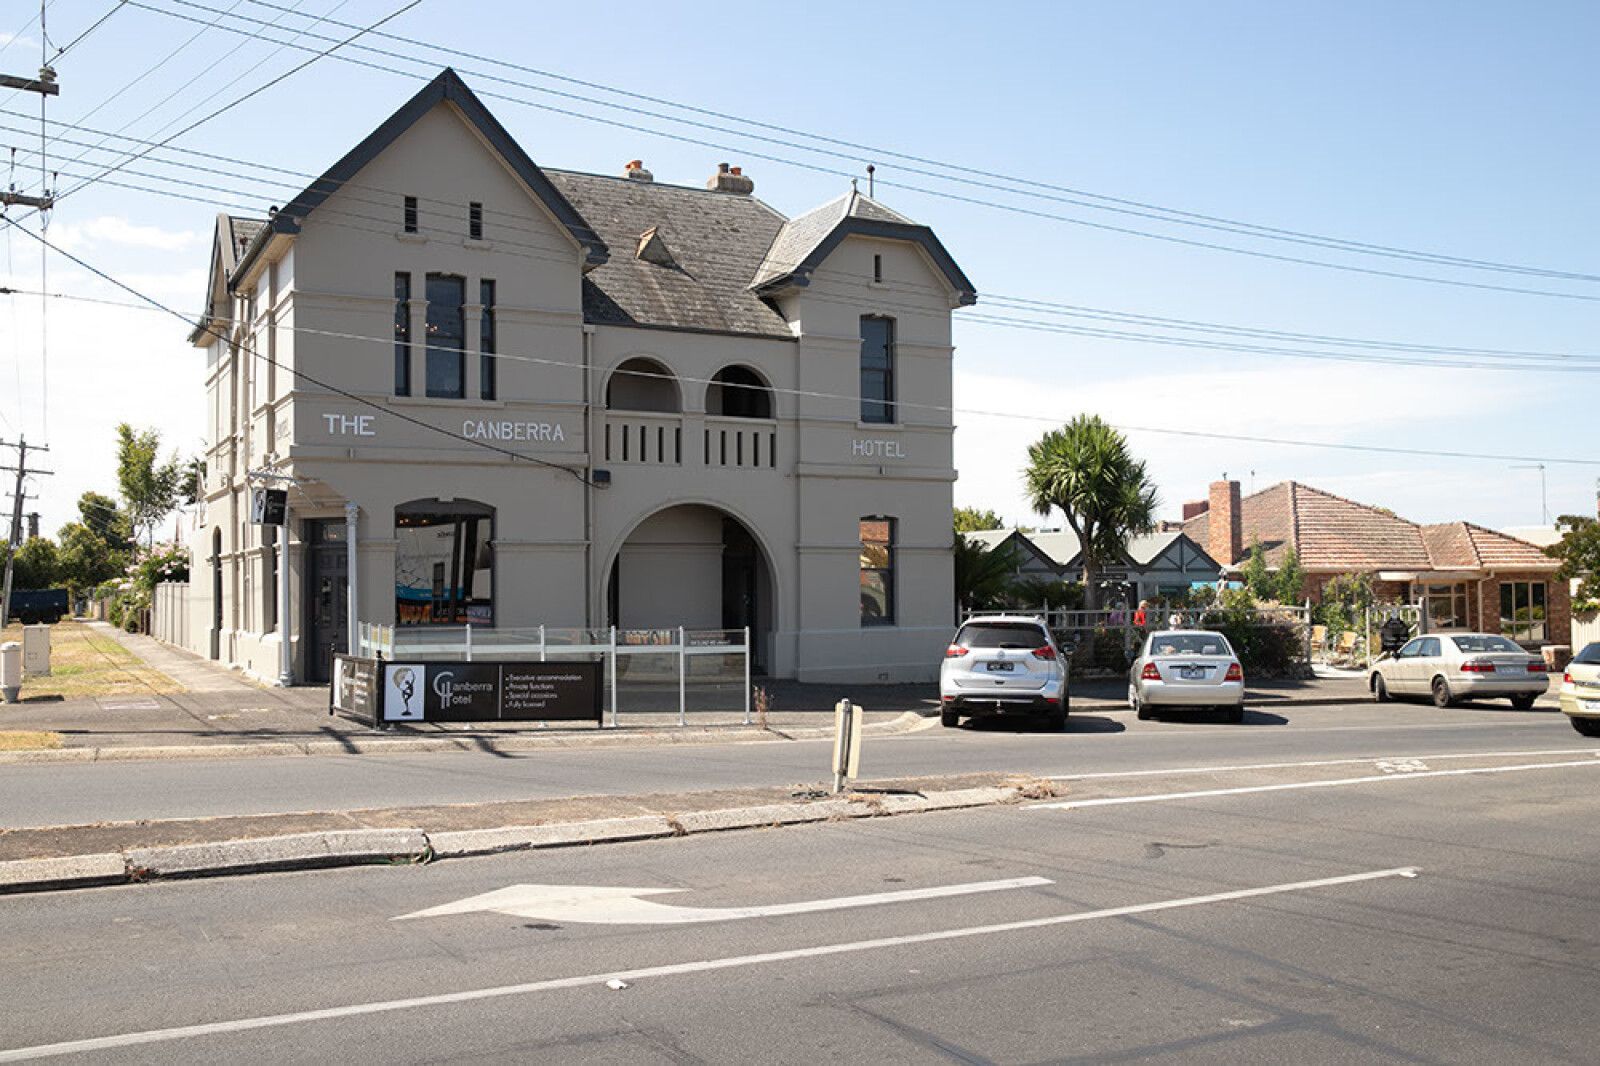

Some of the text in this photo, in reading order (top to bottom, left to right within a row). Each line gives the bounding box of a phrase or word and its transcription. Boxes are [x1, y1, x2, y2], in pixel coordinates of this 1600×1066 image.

[322, 413, 905, 457] THE CANBERRA HOTEL
